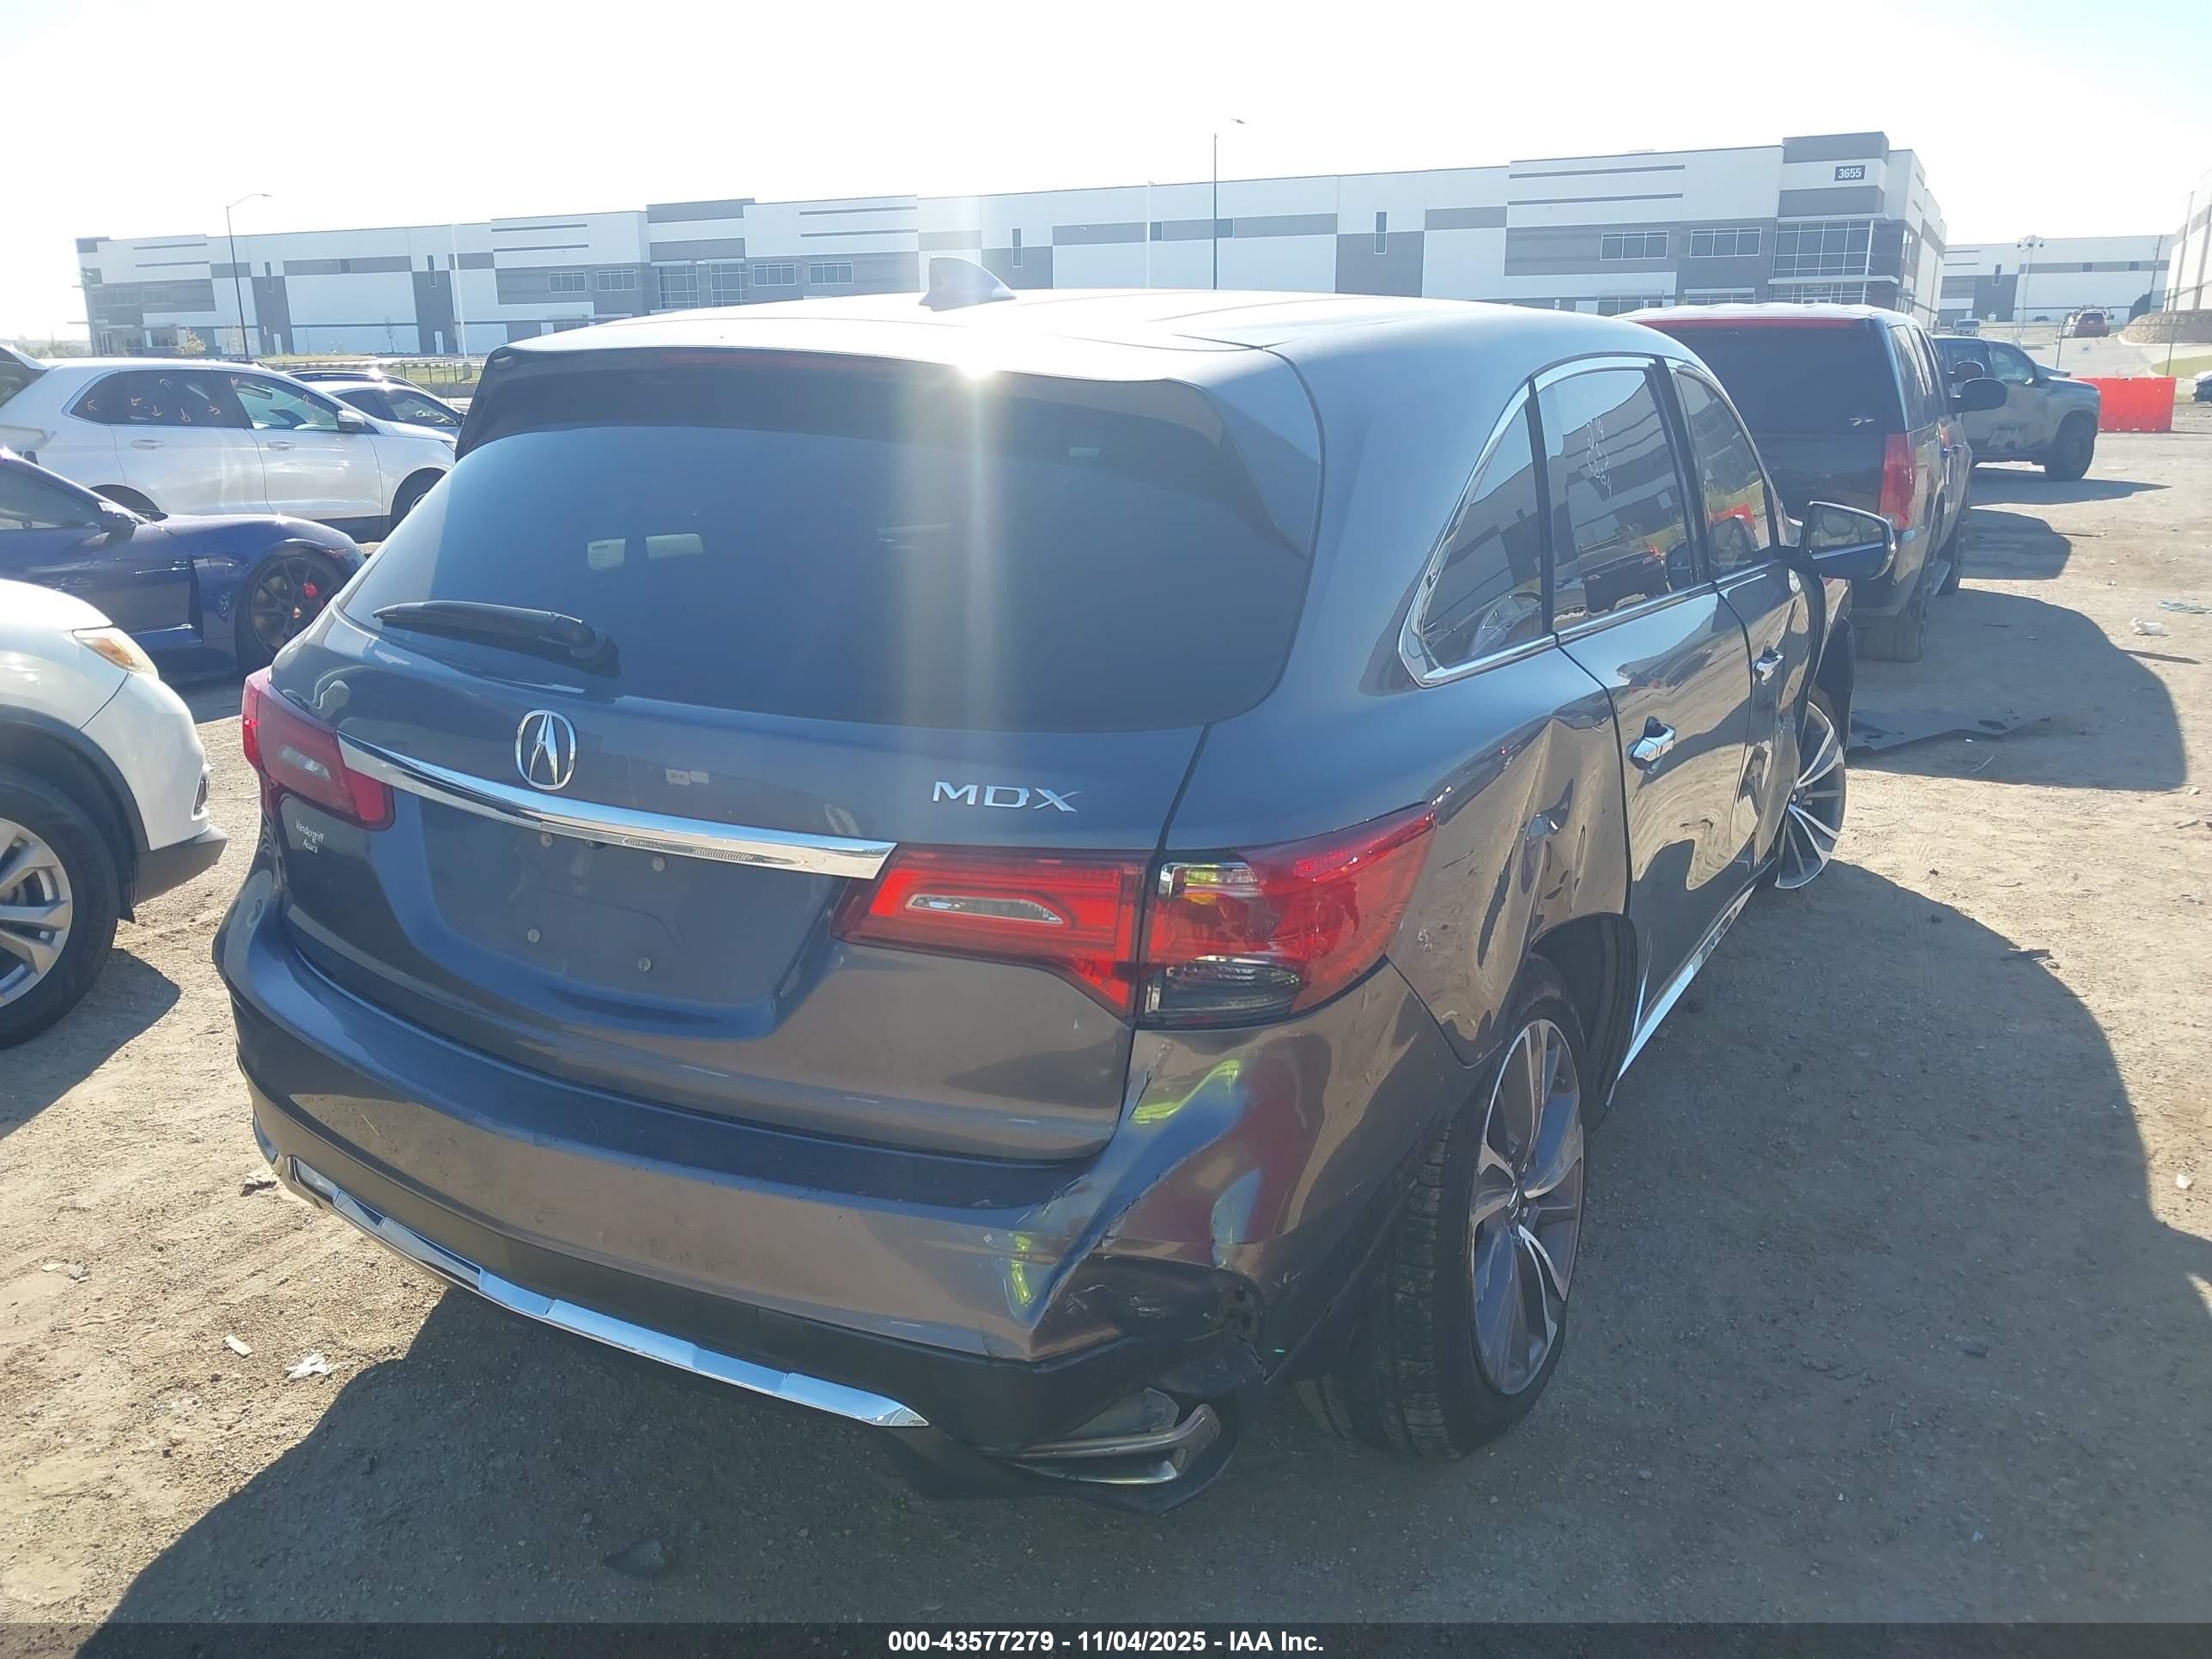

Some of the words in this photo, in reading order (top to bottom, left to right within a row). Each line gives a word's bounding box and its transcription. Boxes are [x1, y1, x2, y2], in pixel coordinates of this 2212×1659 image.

[1838, 167, 1862, 179] 3655
[933, 781, 1083, 812] MDX
[295, 817, 325, 844] Vandergriff
[303, 838, 318, 854] Acura
